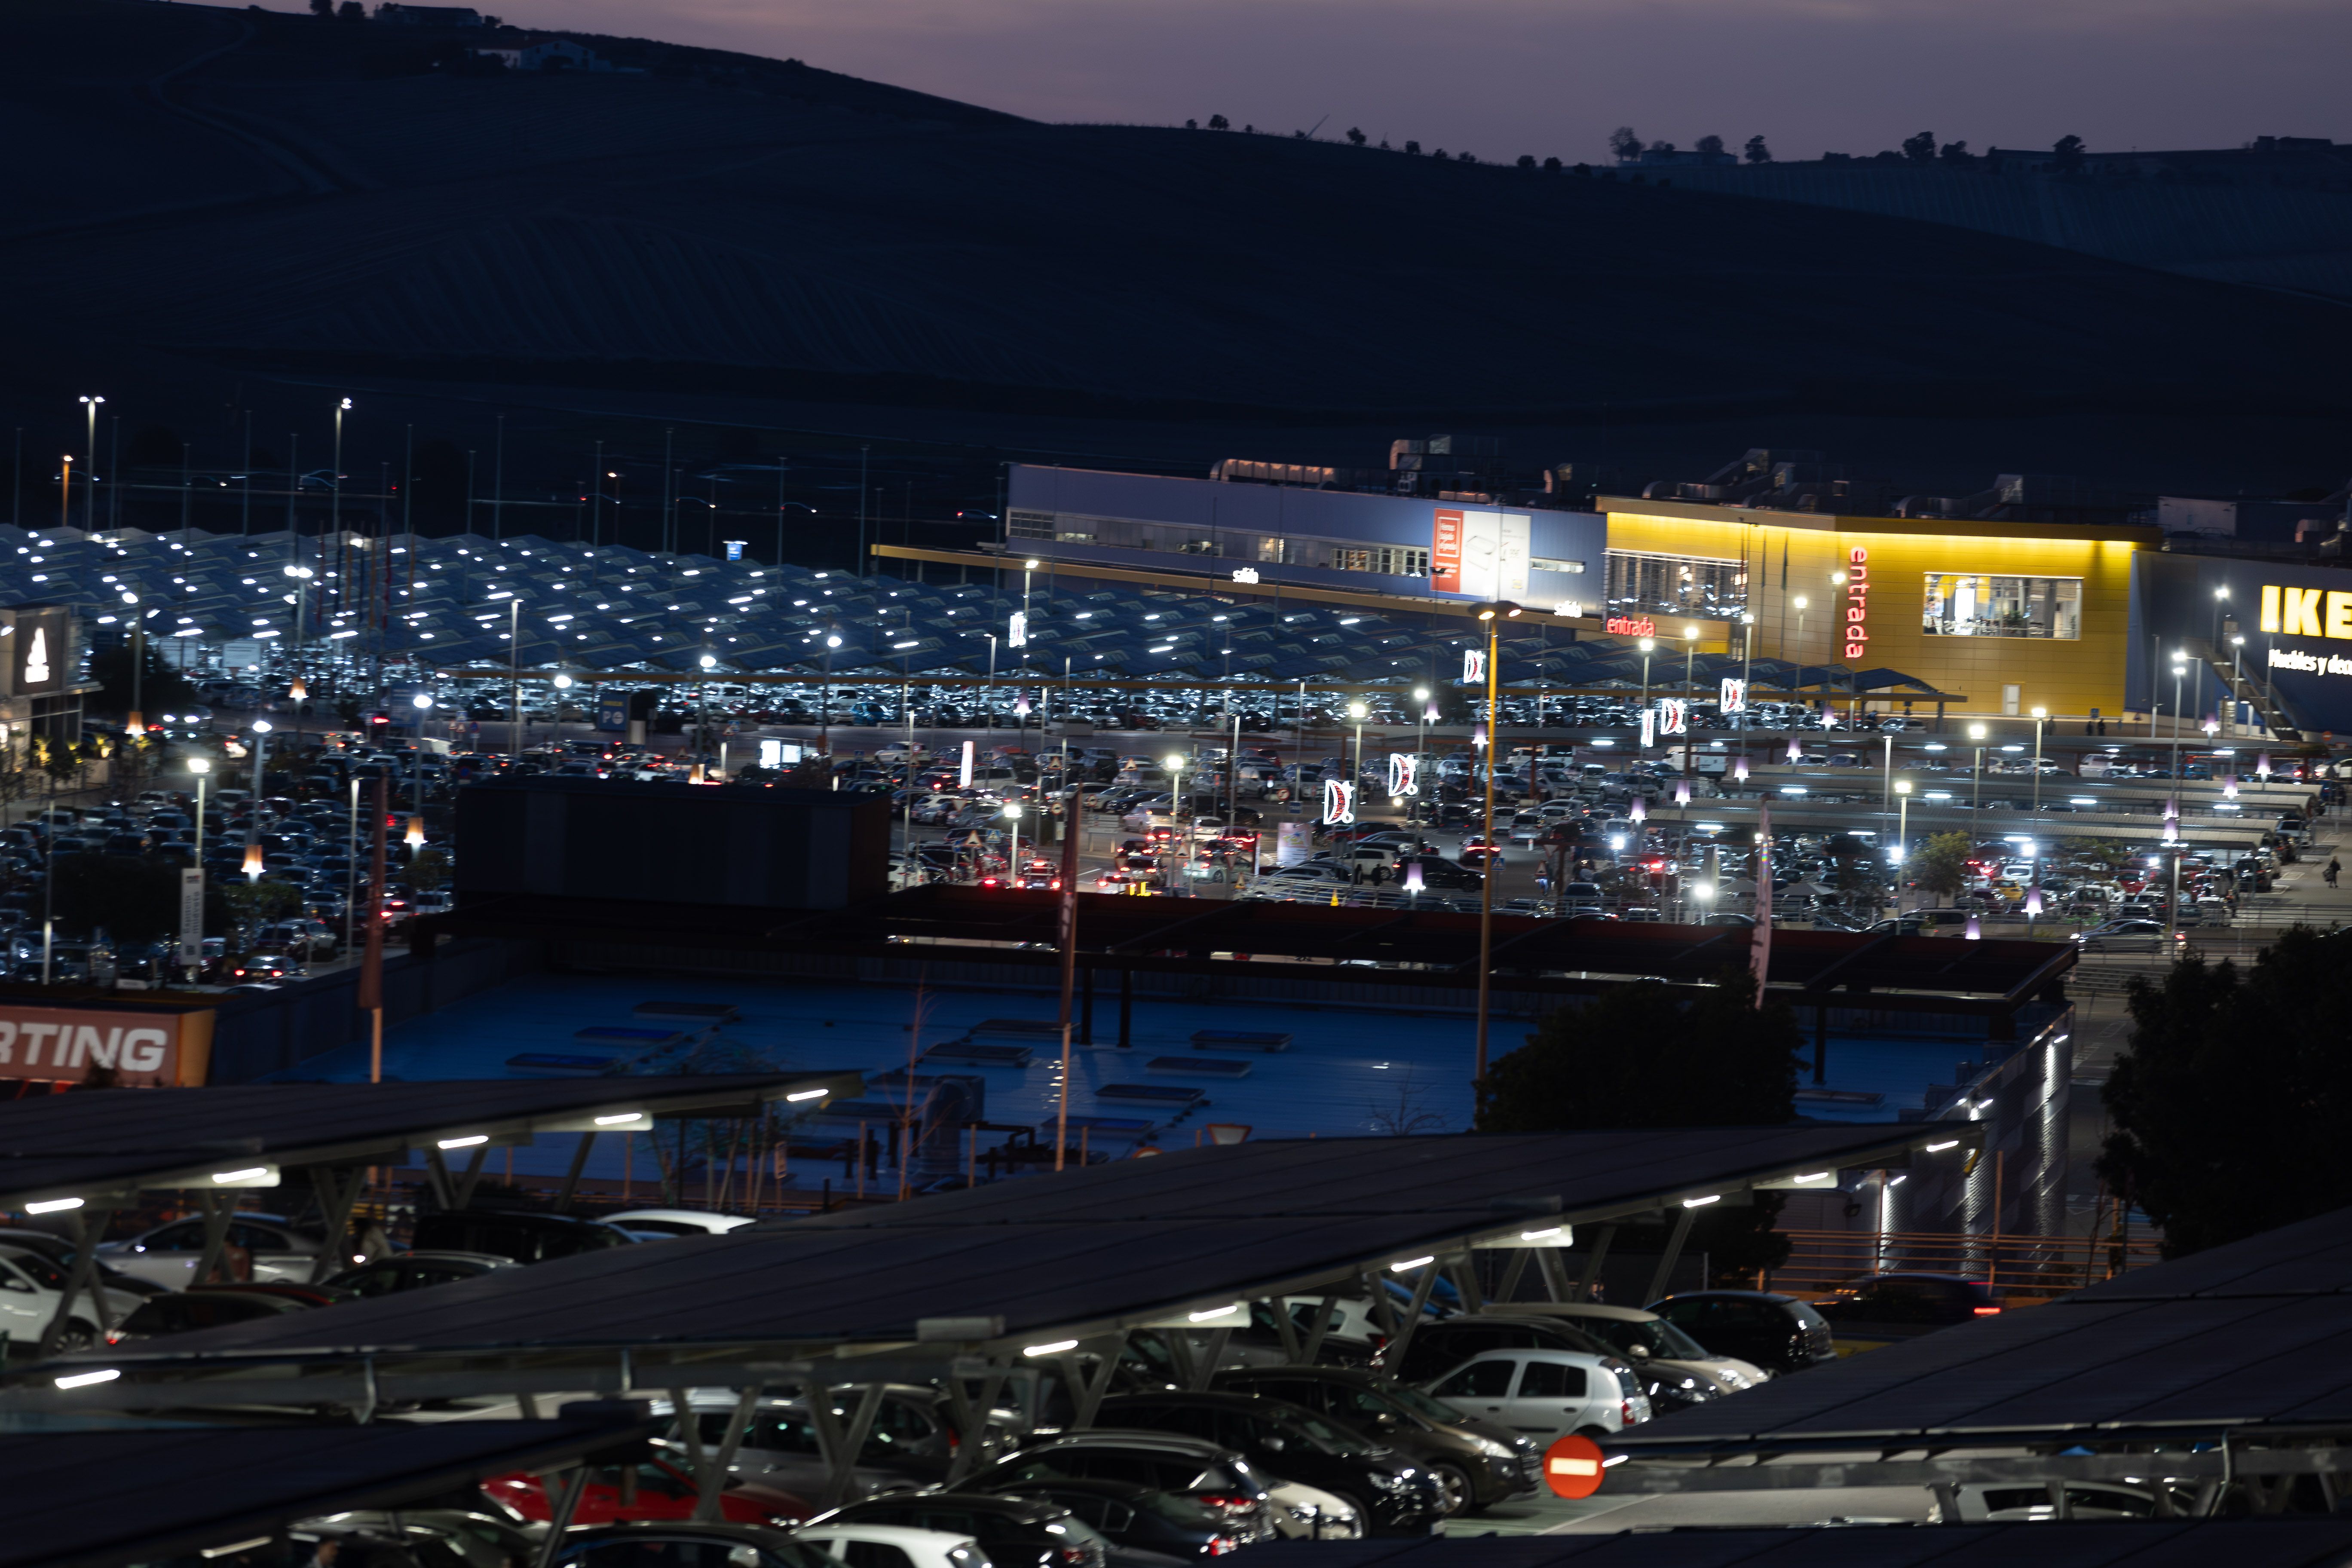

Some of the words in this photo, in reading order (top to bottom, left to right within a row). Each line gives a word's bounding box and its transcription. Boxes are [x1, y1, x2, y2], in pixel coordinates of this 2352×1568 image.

[1845, 546, 1870, 658] entrada
[1607, 616, 1655, 637] entrada
[2317, 657, 2328, 676] y
